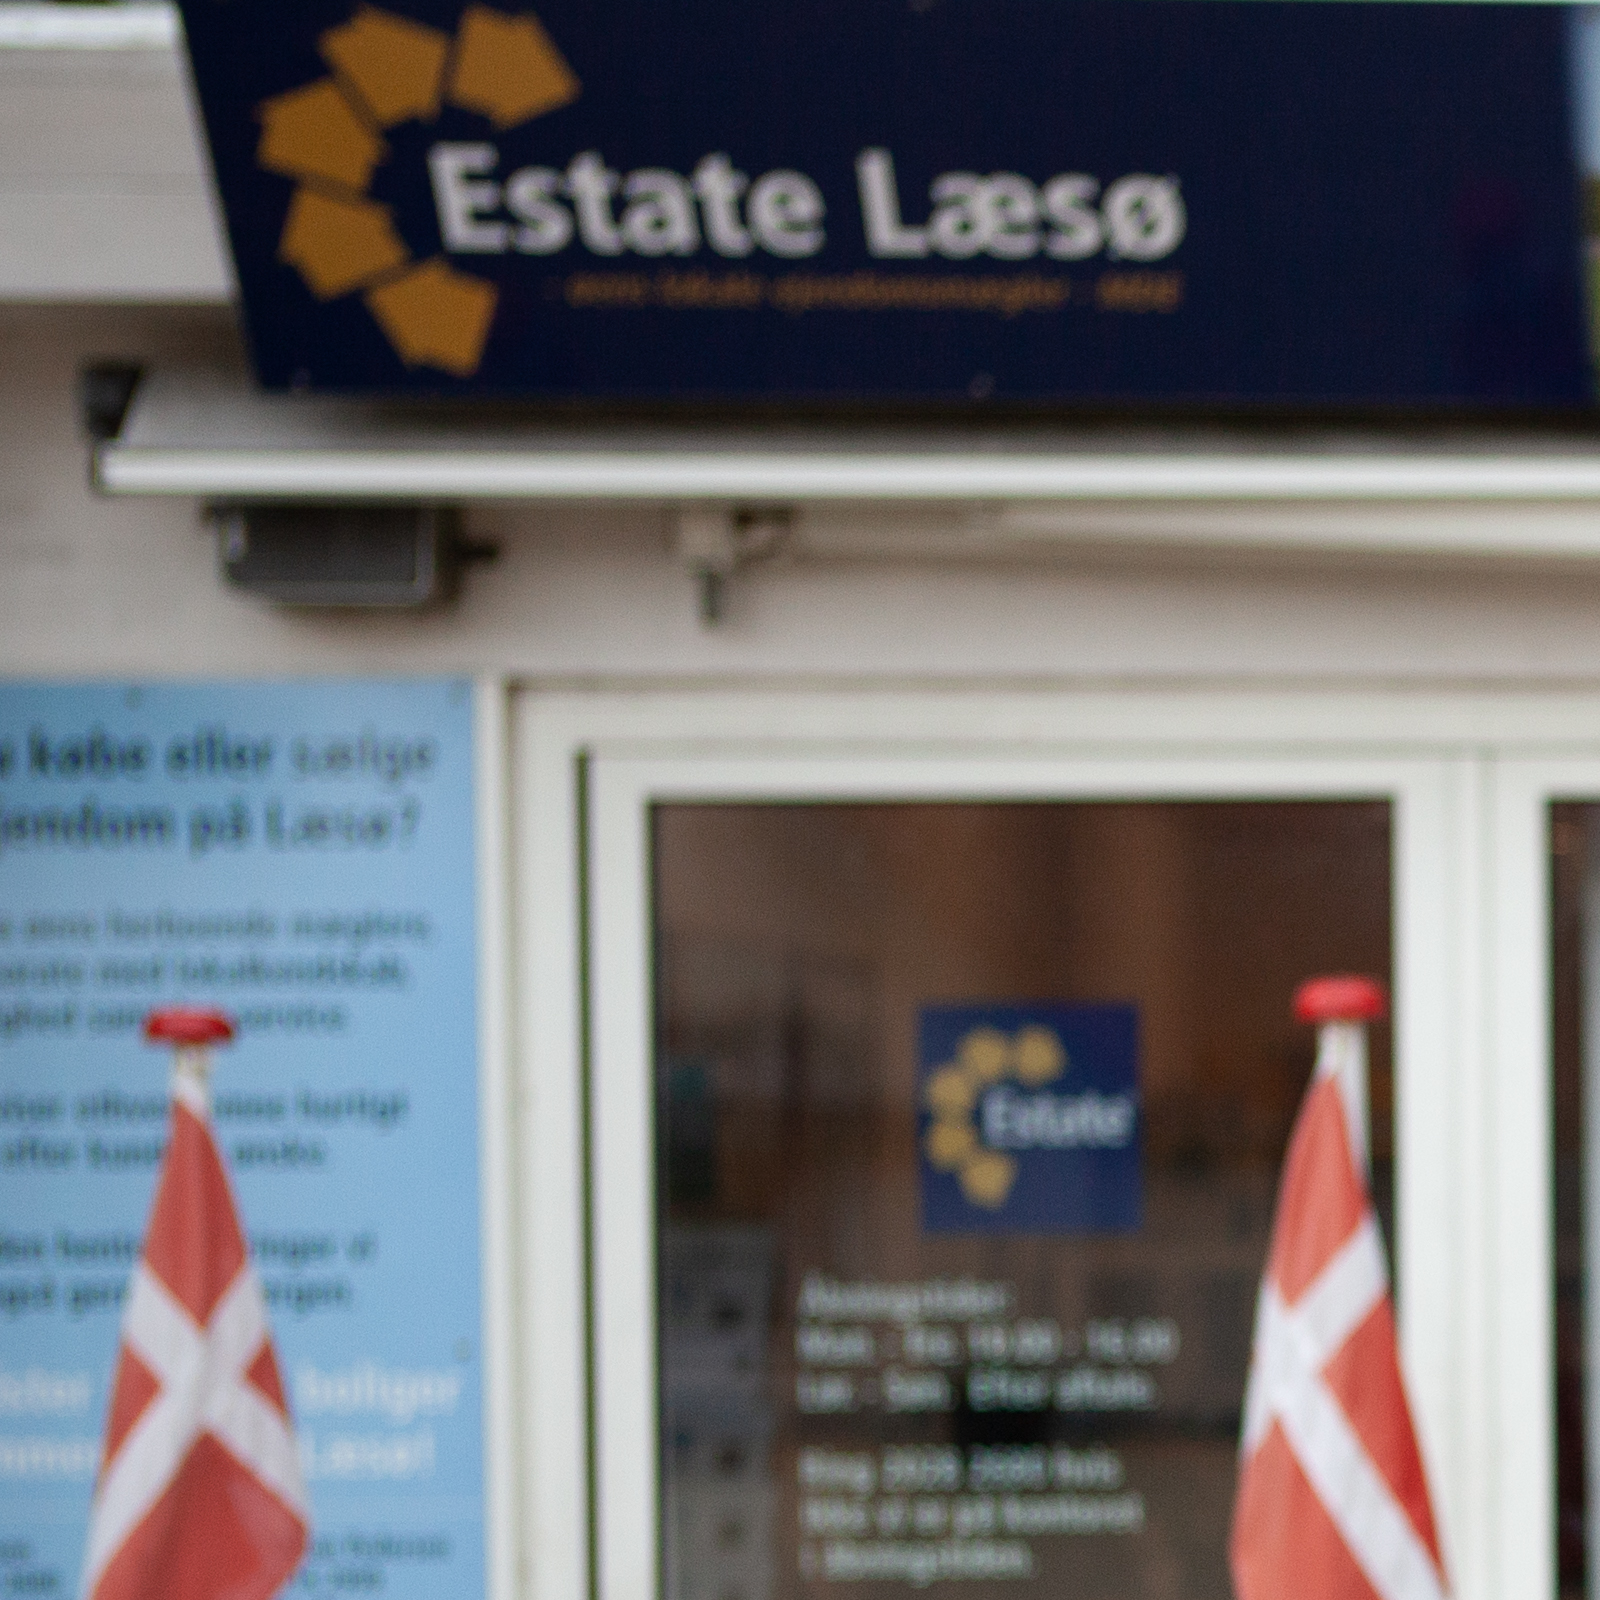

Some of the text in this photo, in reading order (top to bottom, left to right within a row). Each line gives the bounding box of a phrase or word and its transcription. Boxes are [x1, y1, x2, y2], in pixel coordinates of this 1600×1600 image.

[430, 143, 1186, 261] Estate Læsø
[166, 725, 272, 778] eller
[291, 727, 436, 790] sælge
[190, 795, 249, 860] på
[266, 793, 420, 850] Læsø?
[978, 1091, 1136, 1147] Estate
